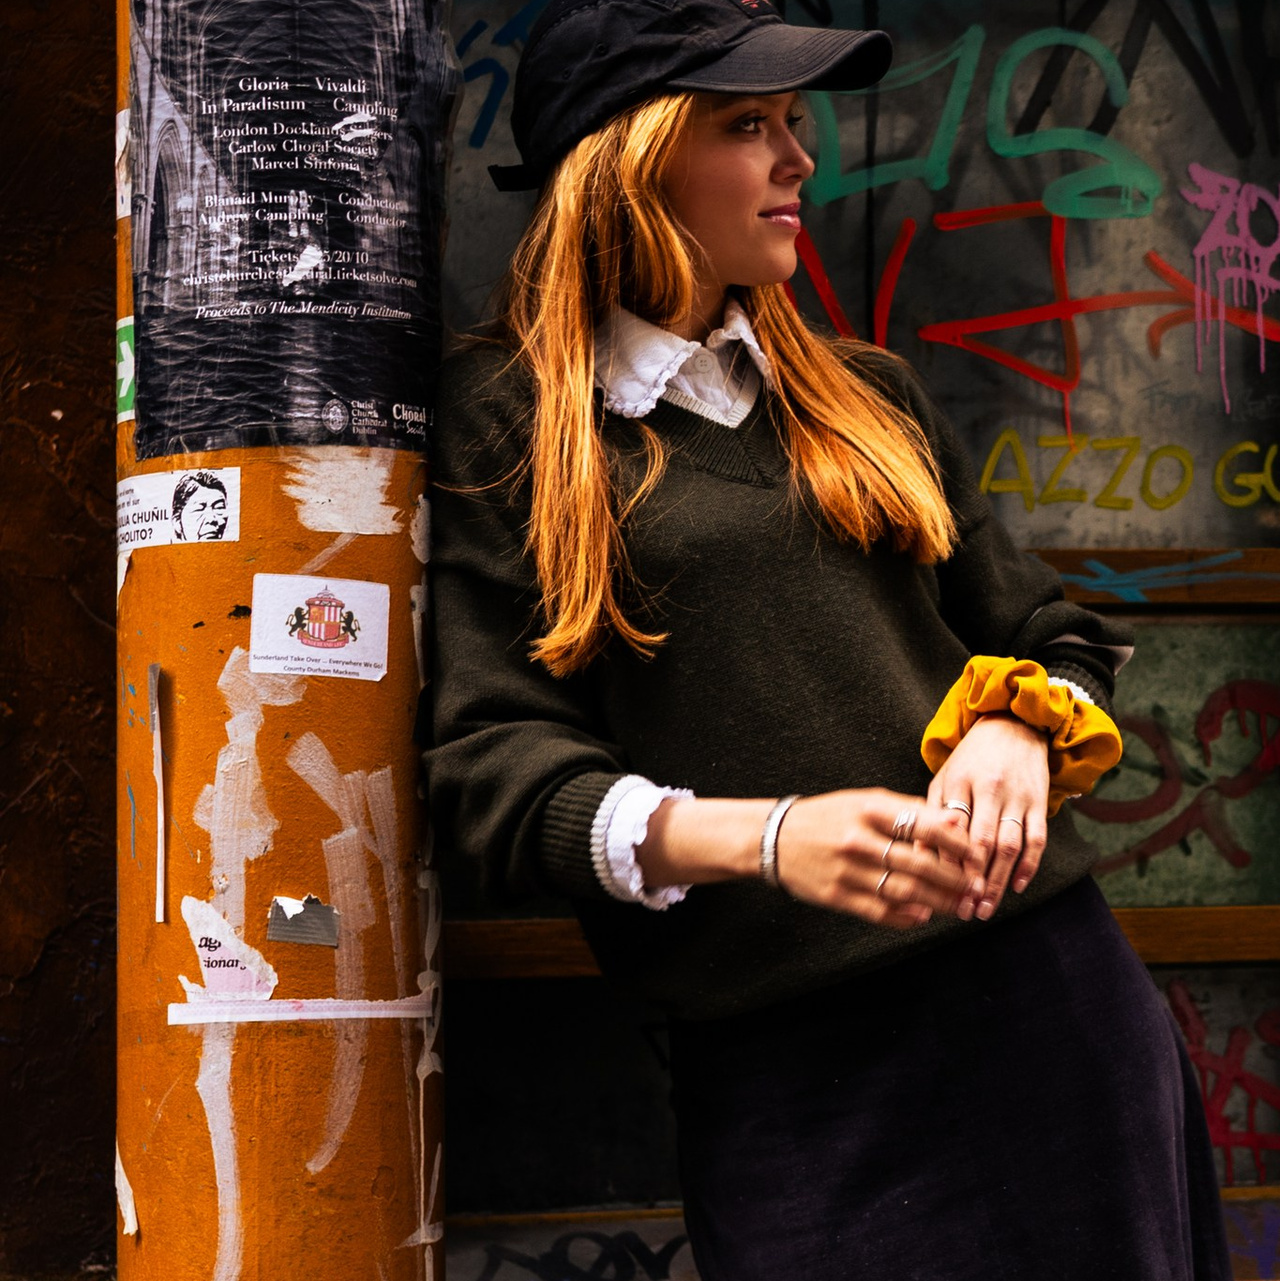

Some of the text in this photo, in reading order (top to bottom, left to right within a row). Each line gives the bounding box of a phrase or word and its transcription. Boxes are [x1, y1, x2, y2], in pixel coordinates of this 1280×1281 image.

[238, 76, 368, 93] Gloria Vivaldi
[201, 96, 399, 121] In Paradisum Campling
[213, 122, 268, 139] London
[229, 138, 379, 157] Carlow Choral Society
[252, 156, 360, 172] Marcel Sinfonia
[261, 191, 316, 207] Murphy
[338, 192, 401, 211] Conductor
[199, 208, 407, 229] Andrew Campling Conductor
[249, 249, 299, 264] Tickets
[195, 300, 412, 320] Proceeds to The Mendicity Institution
[351, 399, 374, 410] Christ
[351, 409, 379, 419] Church
[979, 428, 1194, 511] AZZO
[132, 506, 169, 524] CHUÑIL
[253, 653, 288, 661] Sunderland
[290, 654, 305, 662] Take
[329, 658, 362, 668] Everywhere
[307, 666, 331, 674] Durham
